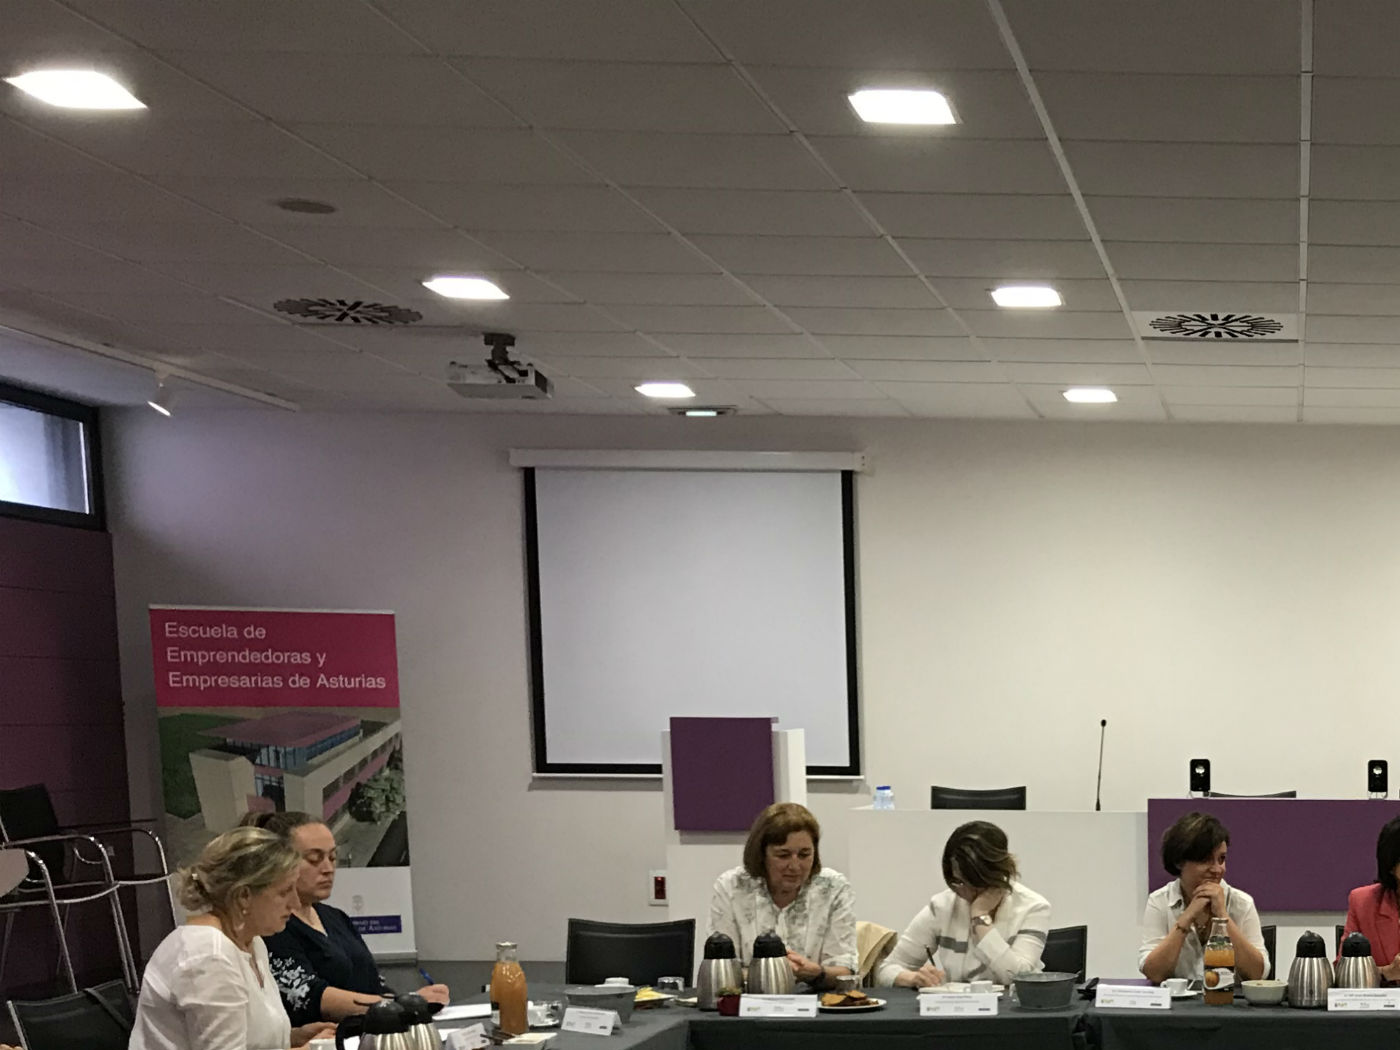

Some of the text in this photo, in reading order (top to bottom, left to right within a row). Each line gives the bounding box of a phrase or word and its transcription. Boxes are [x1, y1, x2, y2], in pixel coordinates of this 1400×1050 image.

[164, 621, 267, 640] Escuela de
[166, 646, 327, 668] Emprendedoras y
[168, 671, 387, 691] Empresarias de Asturias
